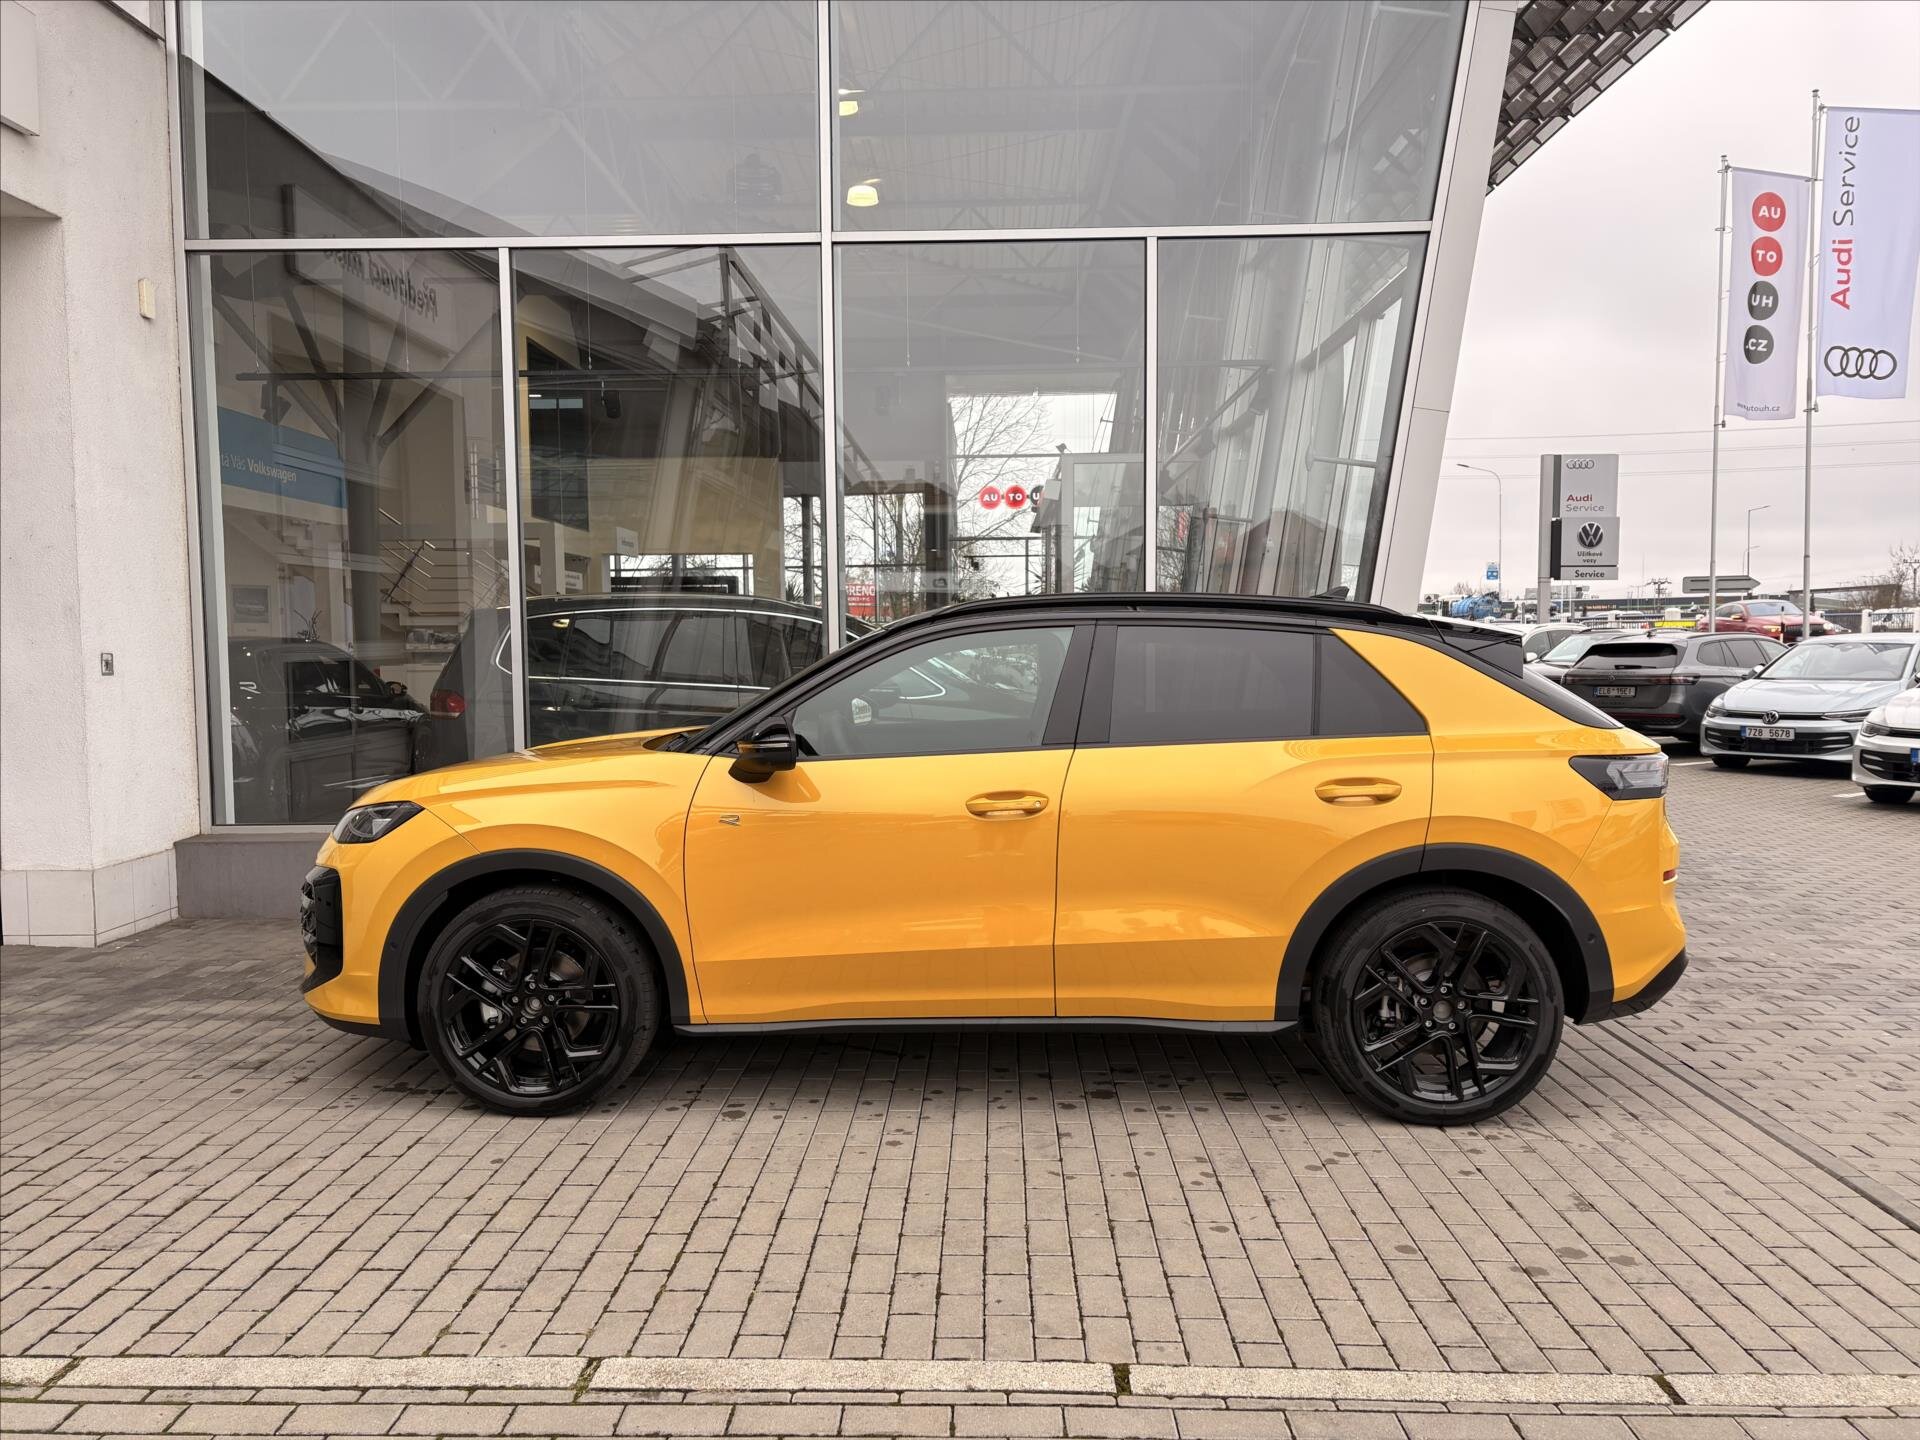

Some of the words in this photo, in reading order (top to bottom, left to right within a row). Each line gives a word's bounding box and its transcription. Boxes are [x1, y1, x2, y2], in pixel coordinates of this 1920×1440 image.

[1832, 116, 1860, 226] Service
[1758, 205, 1781, 219] AU
[1756, 249, 1777, 263] TO
[1830, 239, 1853, 310] Audi
[1751, 293, 1773, 308] UH
[247, 456, 297, 484] Volkswagen
[1566, 494, 1593, 502] Audi
[1565, 503, 1605, 512] Service
[1574, 569, 1605, 578] Service
[1747, 727, 1764, 737] 7Z8
[1769, 728, 1791, 738] 5678
